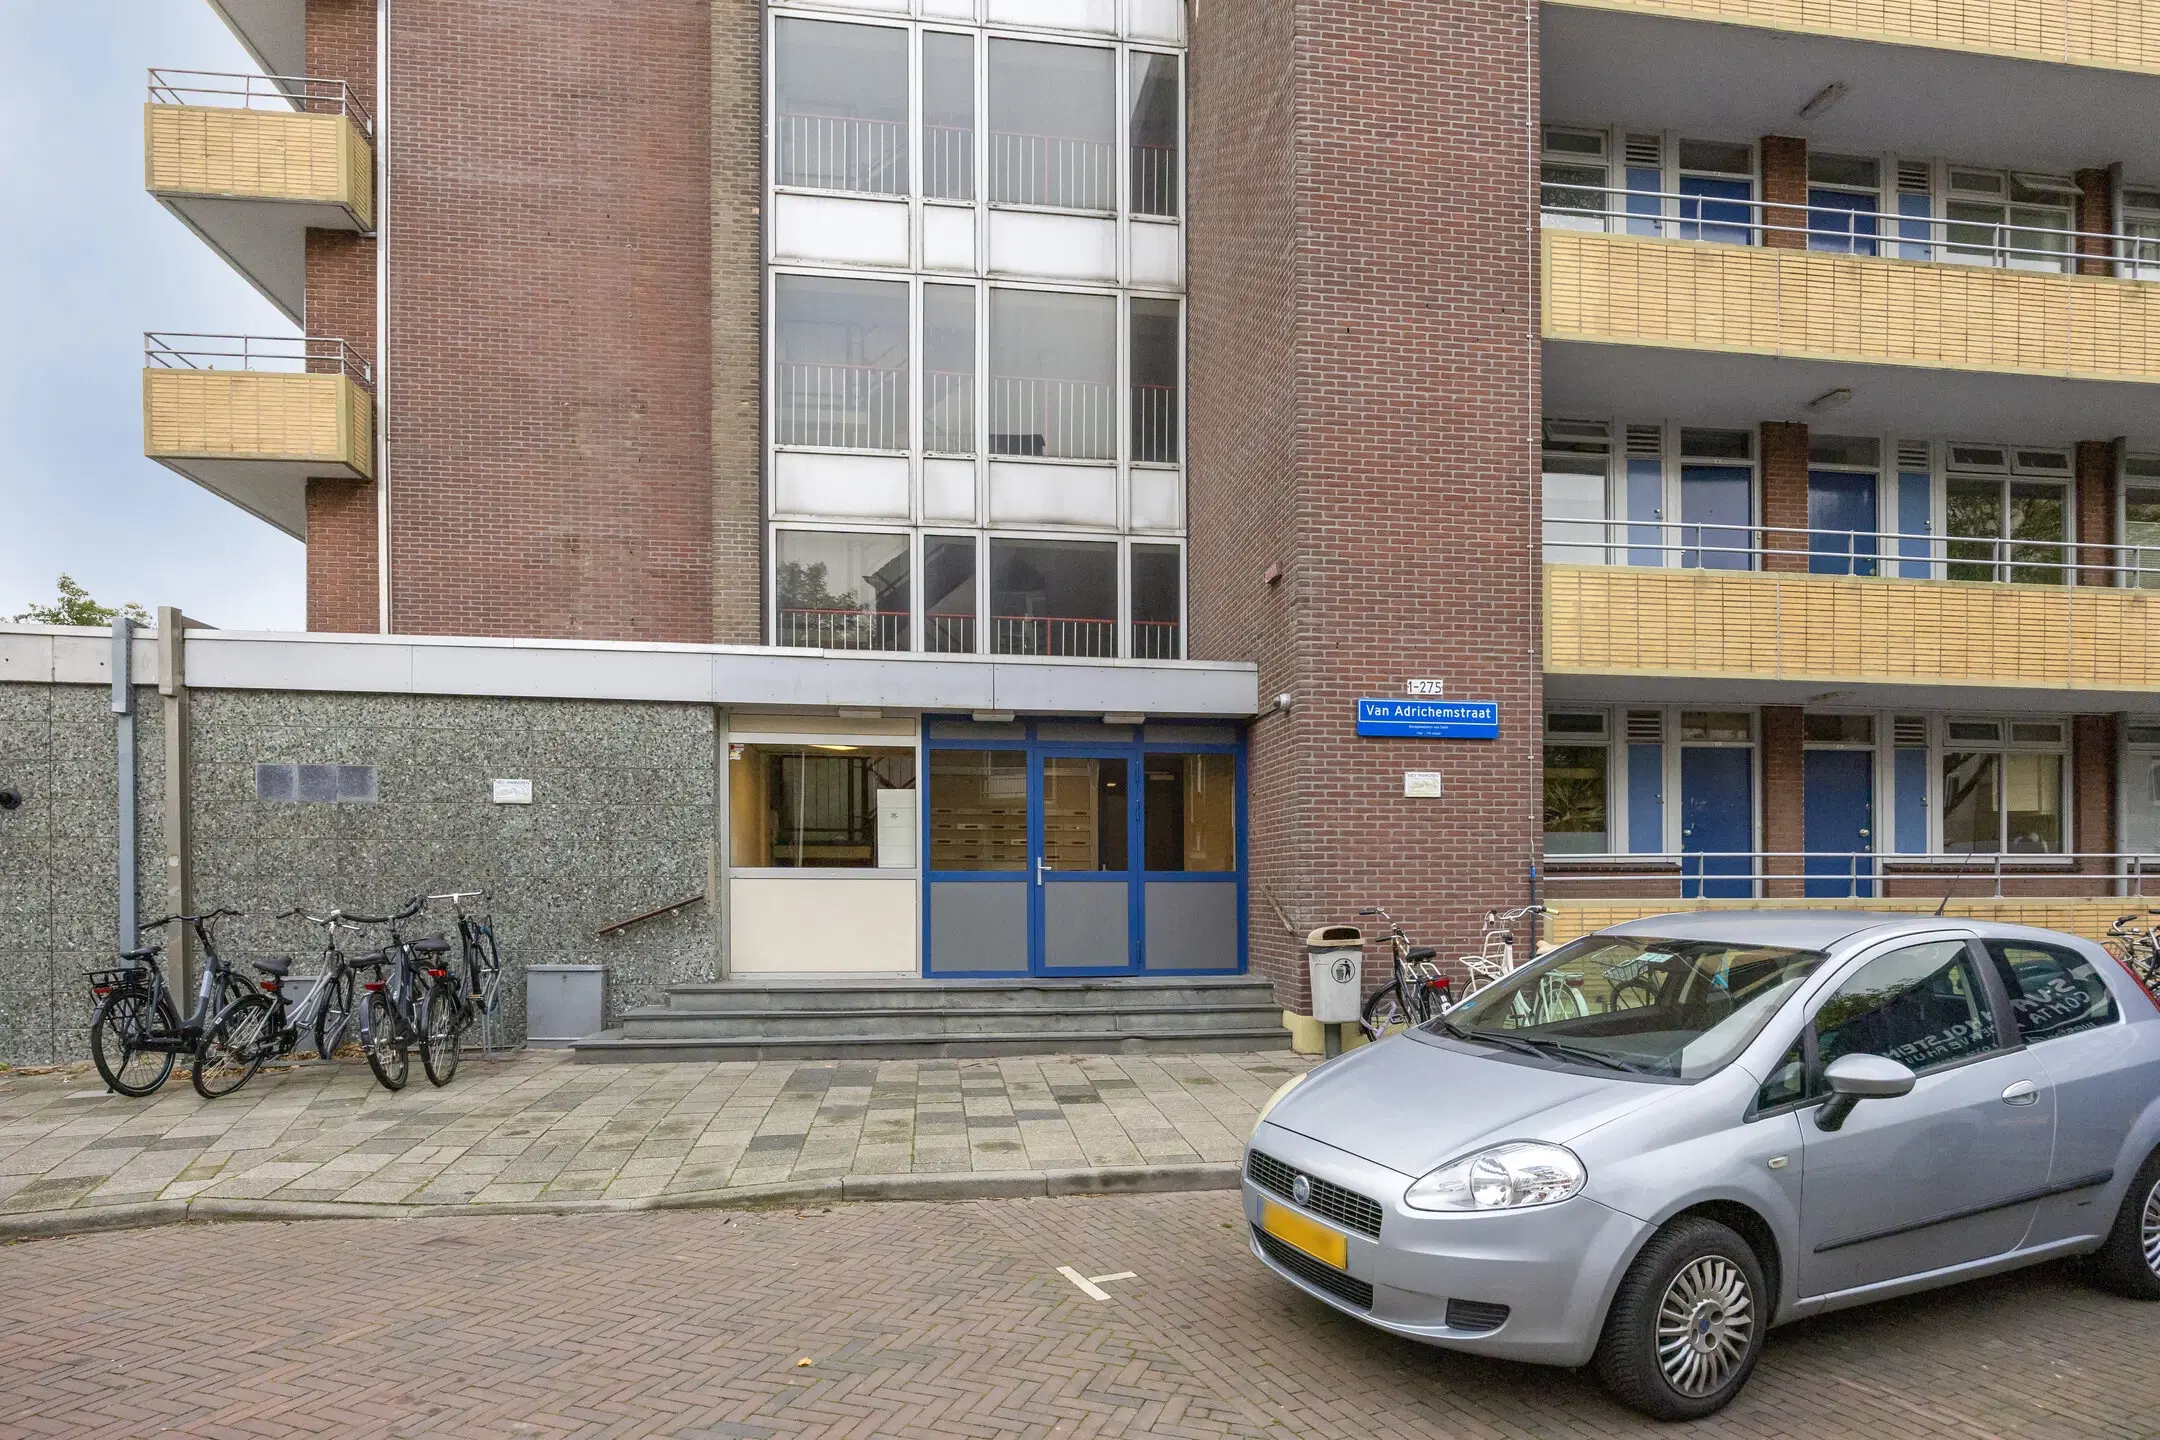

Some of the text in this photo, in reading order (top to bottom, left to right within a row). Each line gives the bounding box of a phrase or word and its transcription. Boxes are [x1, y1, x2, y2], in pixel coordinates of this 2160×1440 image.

[1407, 681, 1442, 694] 1-275
[1366, 704, 1492, 719] Van Adrichemstraat
